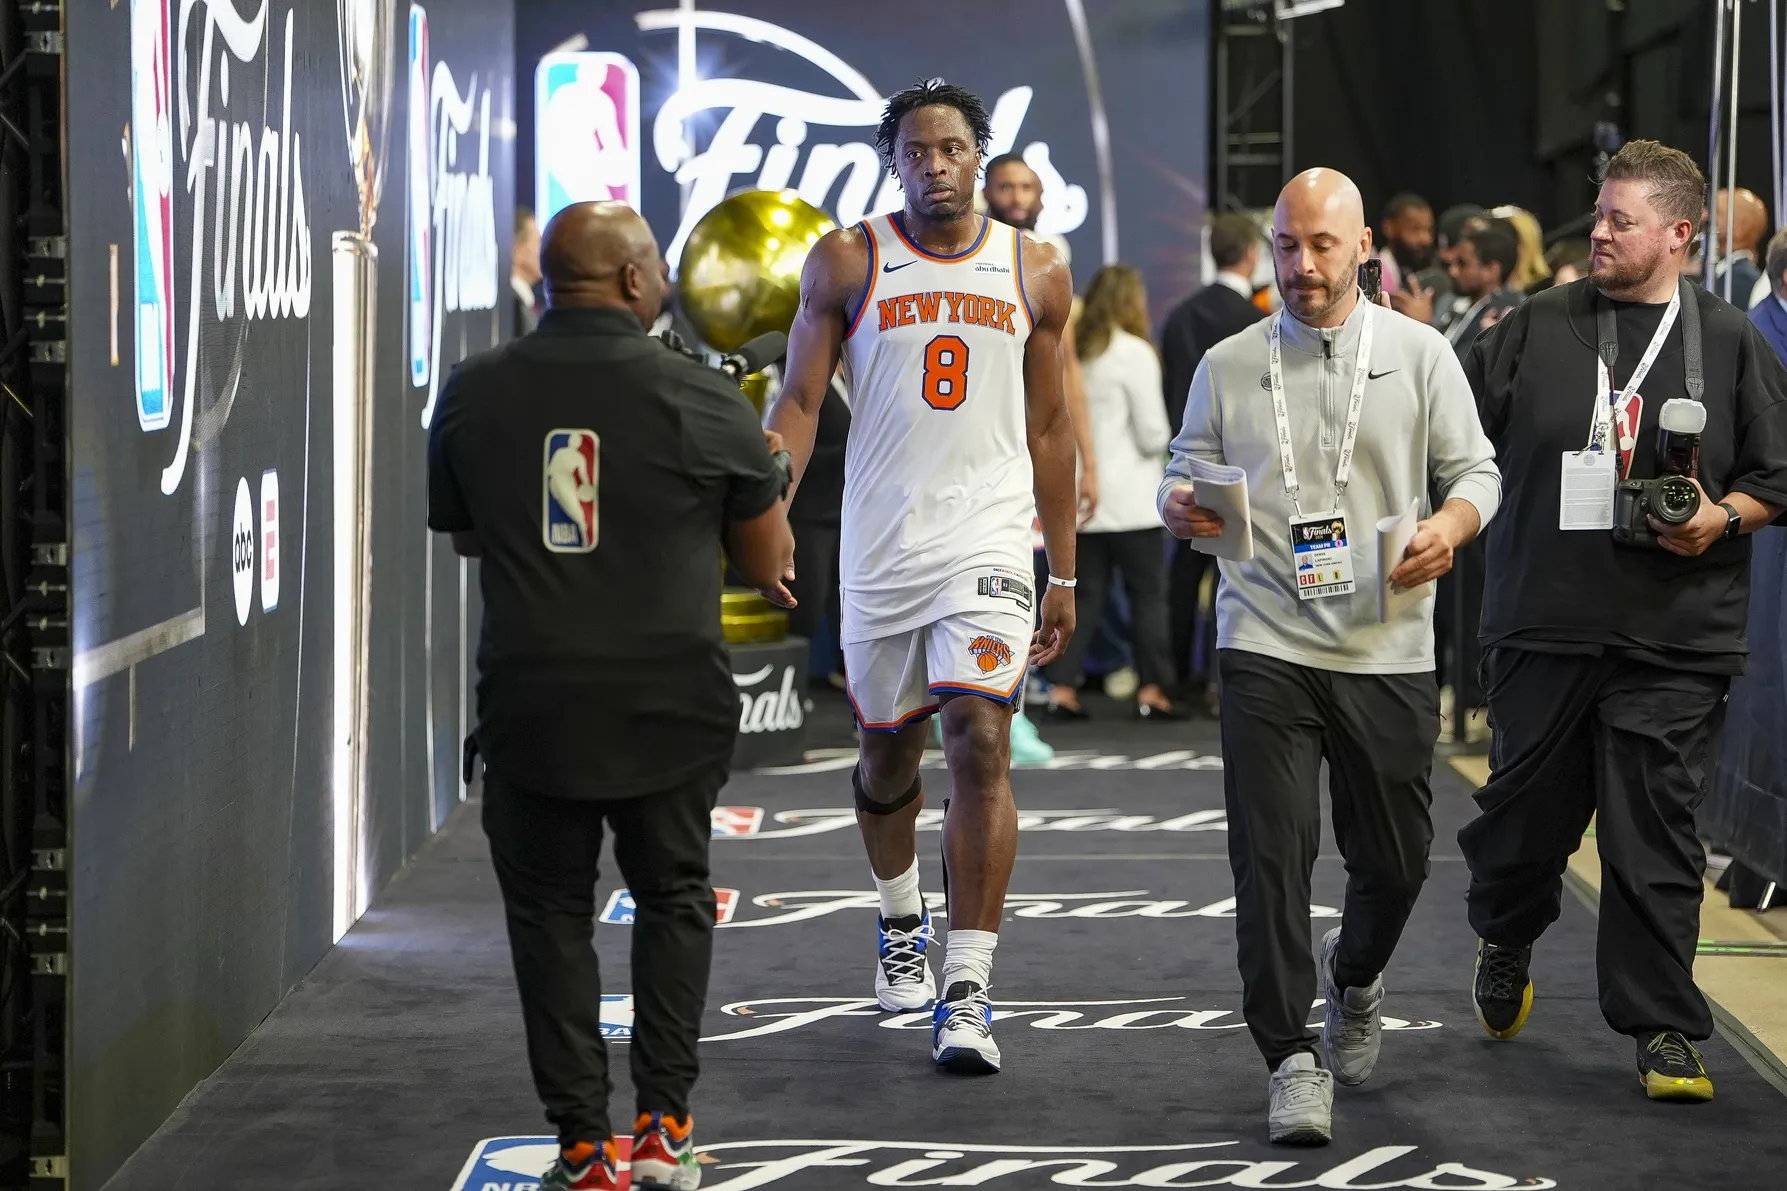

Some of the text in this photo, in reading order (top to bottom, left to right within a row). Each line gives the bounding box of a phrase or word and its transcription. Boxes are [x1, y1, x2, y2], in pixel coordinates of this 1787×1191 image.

[877, 291, 1017, 337] NEW YORK
[921, 334, 970, 411] 8
[235, 522, 252, 573] abc
[1309, 525, 1332, 540] Finals
[968, 636, 1010, 664] KNICKS
[481, 1182, 541, 1191] NB
[690, 1139, 1557, 1191] Finals
